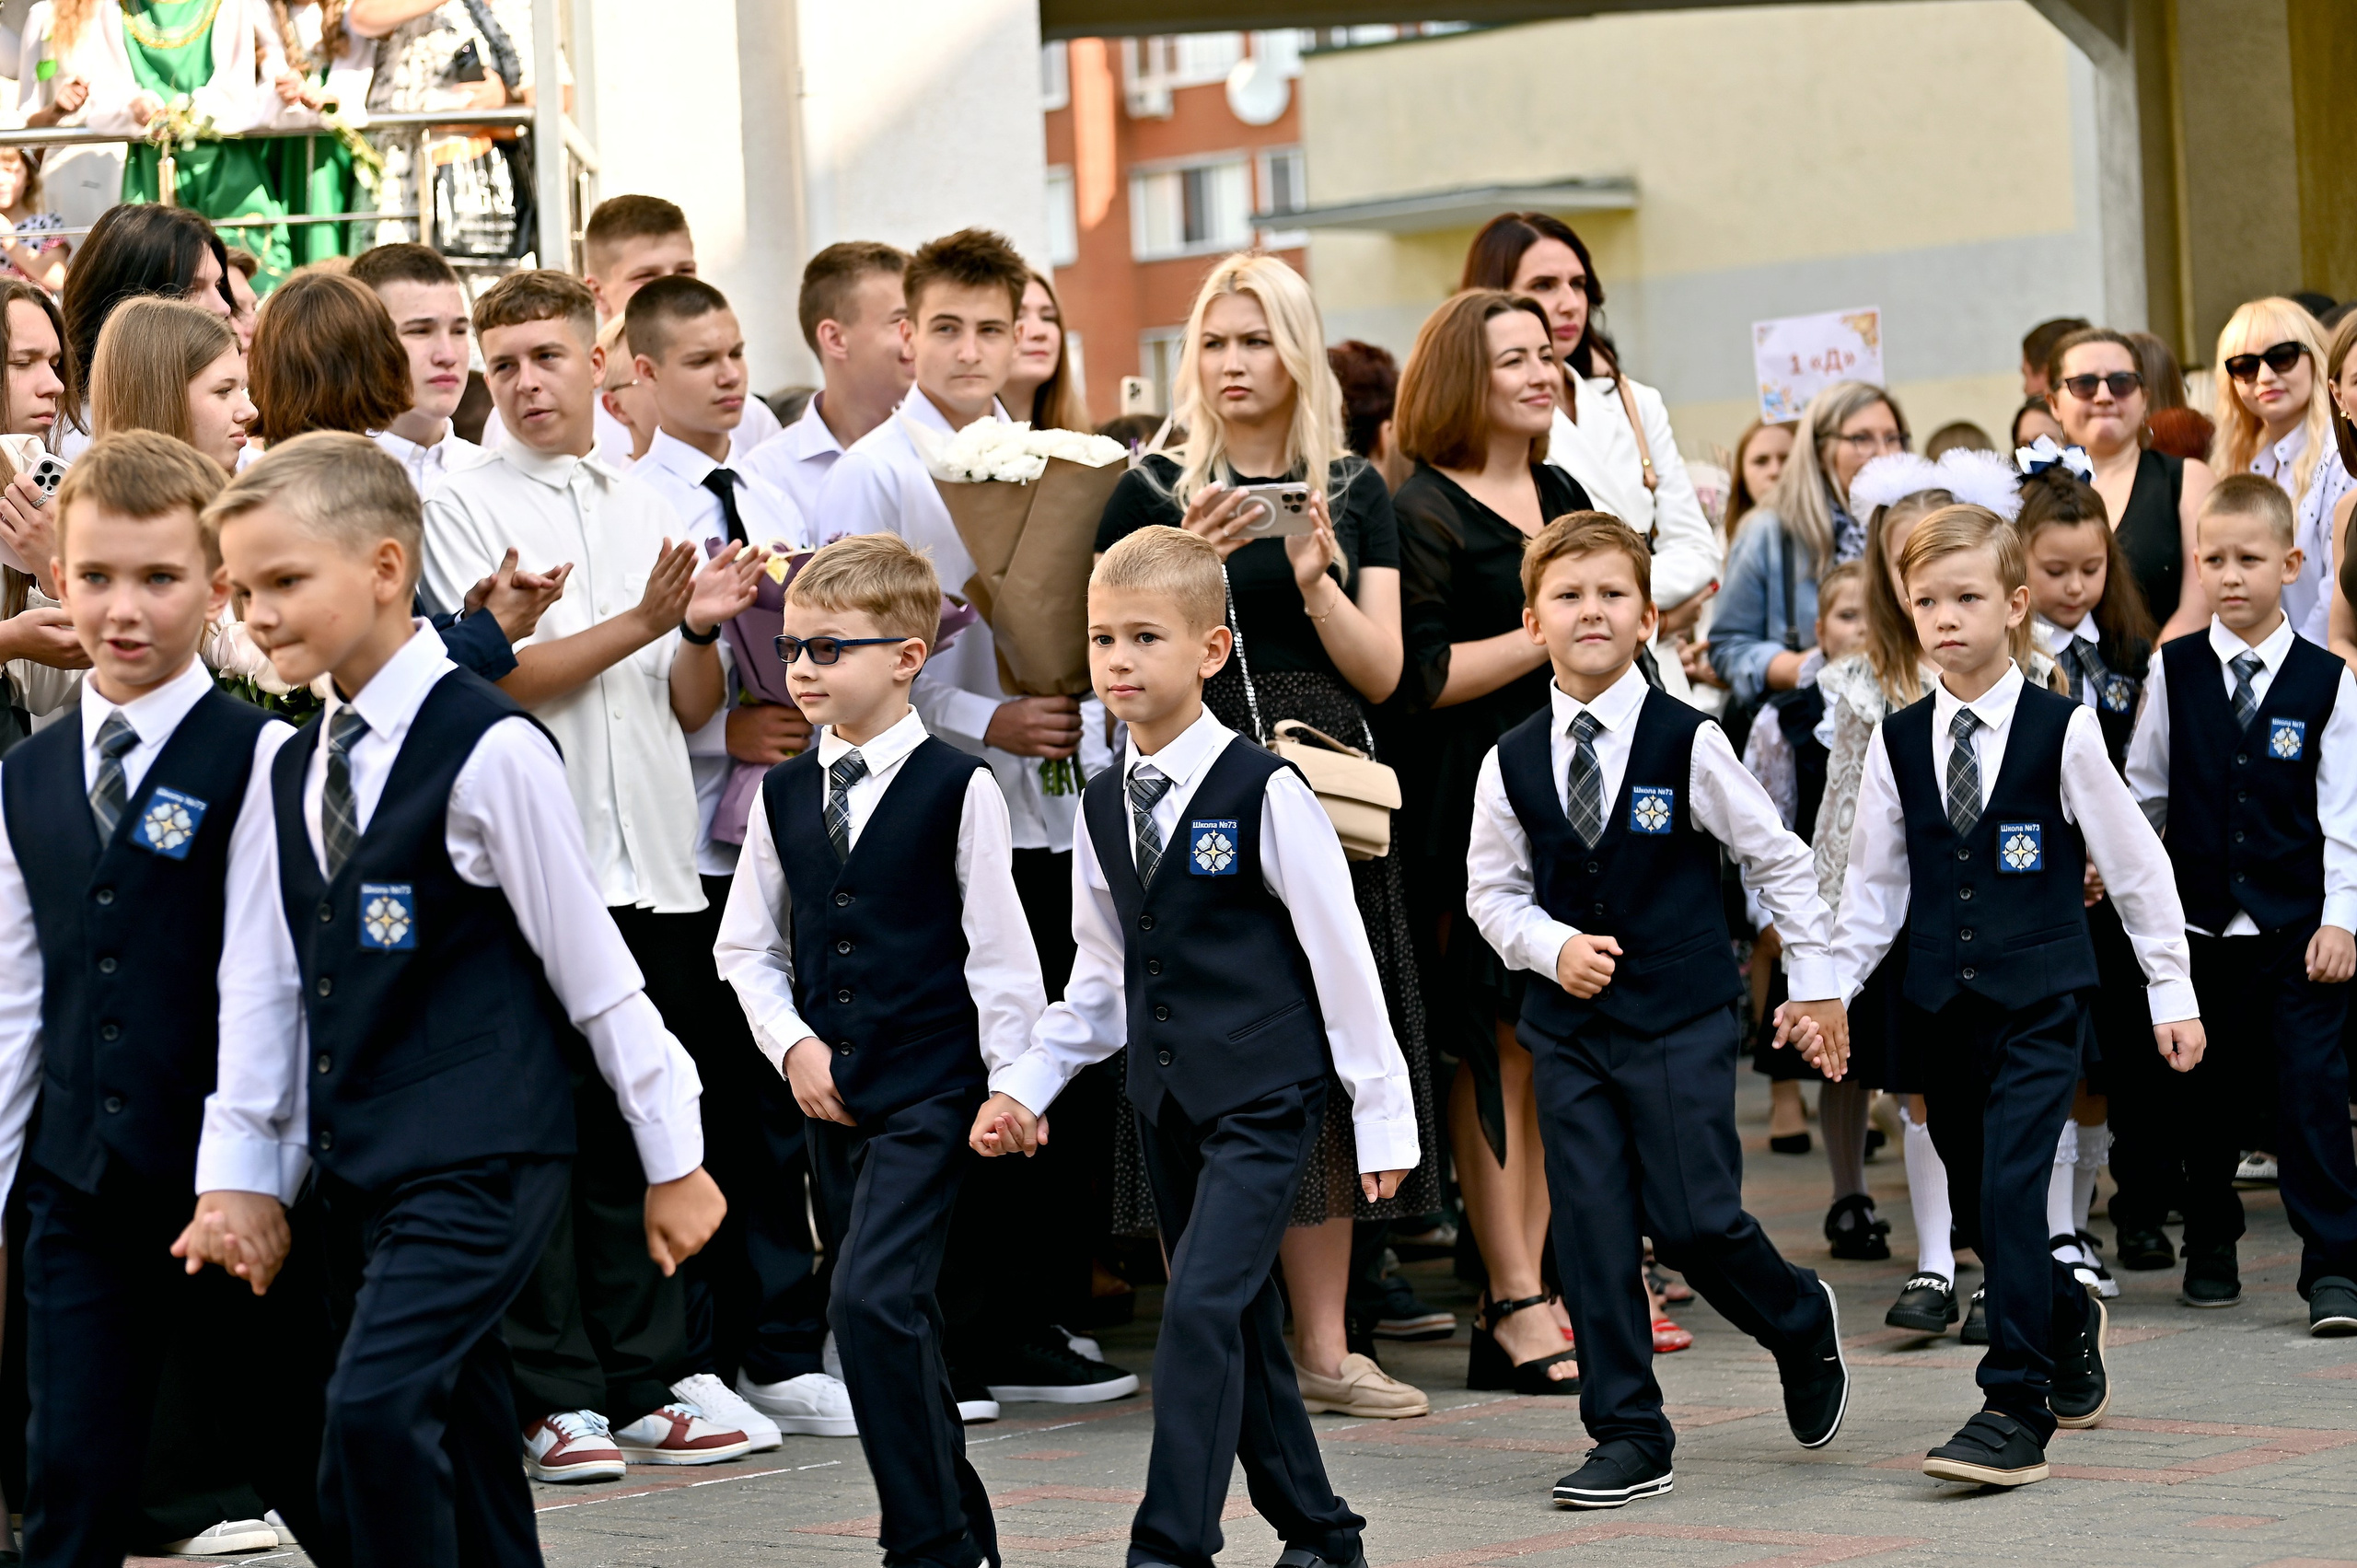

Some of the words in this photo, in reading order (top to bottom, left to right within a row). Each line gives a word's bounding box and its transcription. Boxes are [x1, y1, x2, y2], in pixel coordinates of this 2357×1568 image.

[1790, 352, 1803, 376] 1
[1809, 347, 1856, 376] «Д»
[1633, 786, 1656, 795] Школа
[1657, 788, 1673, 796] №73
[1219, 820, 1237, 830] №73
[2001, 824, 2024, 832] Школа
[2025, 823, 2040, 831] №73
